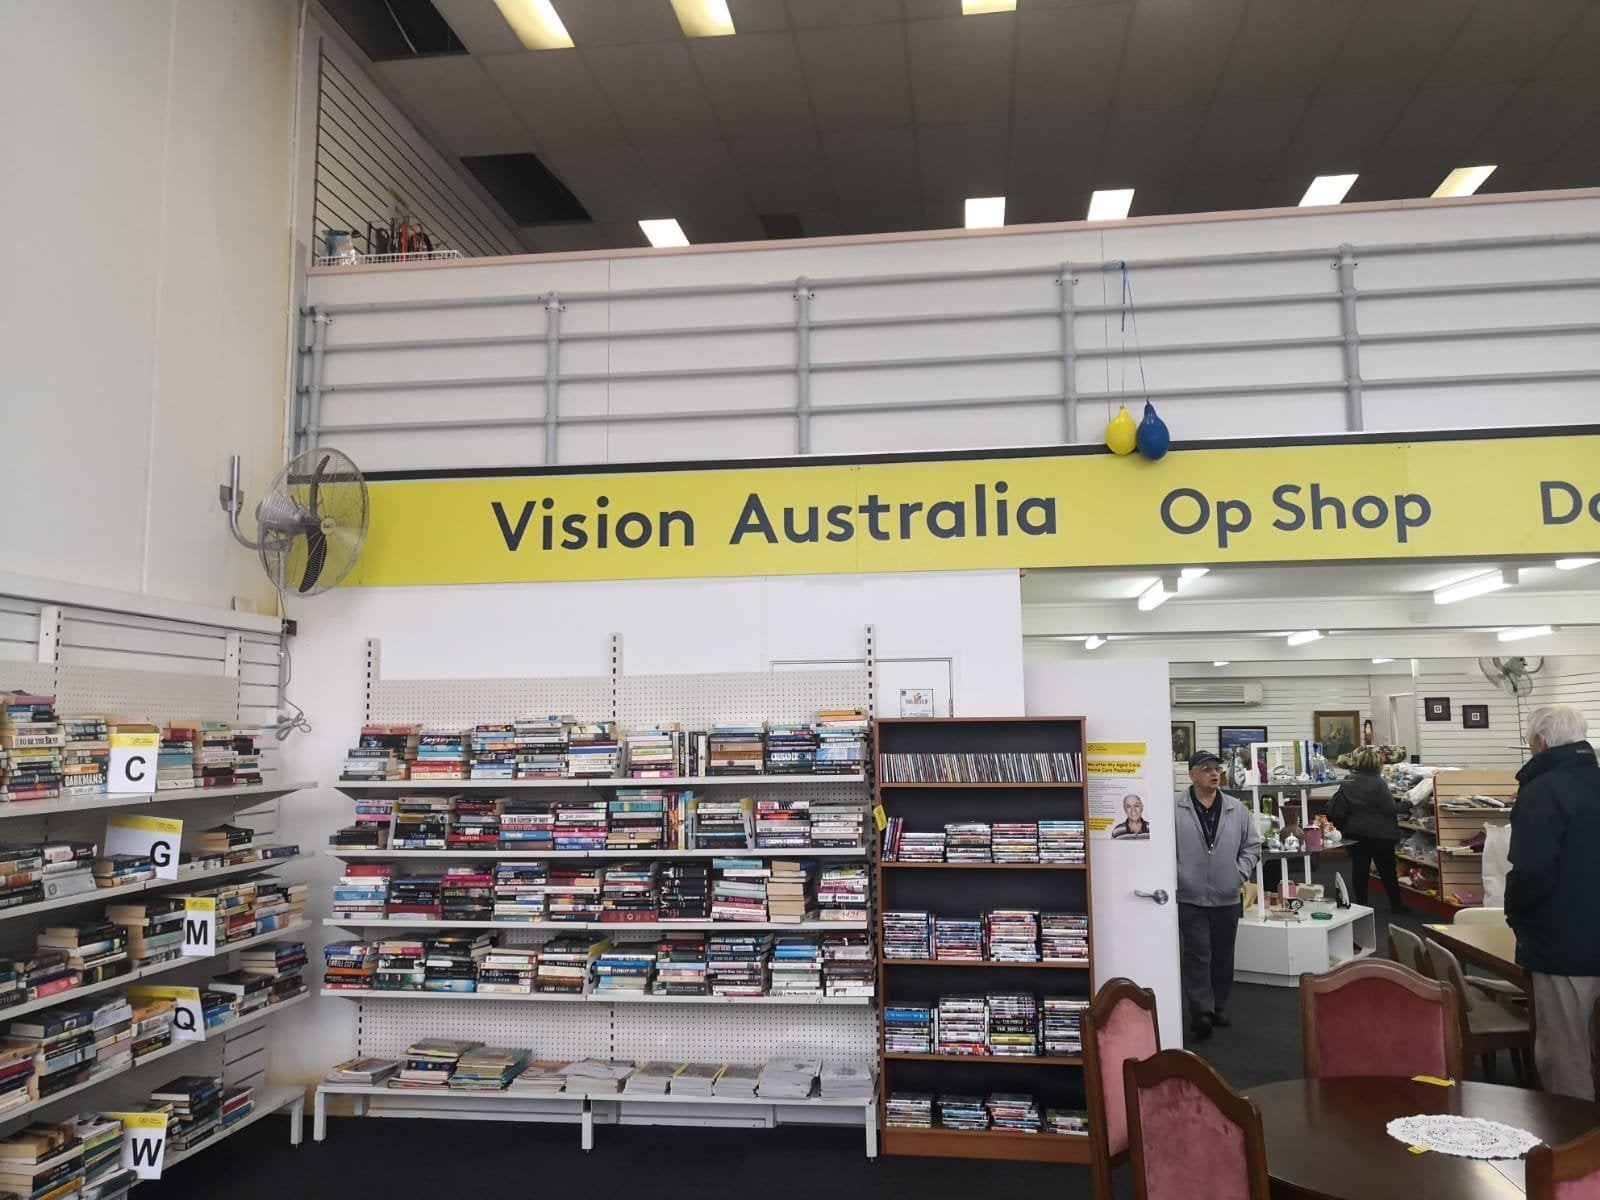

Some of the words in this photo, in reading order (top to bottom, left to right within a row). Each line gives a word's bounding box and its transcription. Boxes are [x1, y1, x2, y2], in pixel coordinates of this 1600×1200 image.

[491, 496, 695, 552] Vision
[729, 480, 1057, 546] Australia
[1160, 487, 1252, 549] Op
[1272, 482, 1432, 543] Shop
[64, 773, 103, 787] DARKMANS
[124, 755, 146, 782] C
[150, 840, 172, 868] G
[186, 919, 209, 945] M
[173, 1006, 197, 1032] Q
[131, 1137, 163, 1167] W
